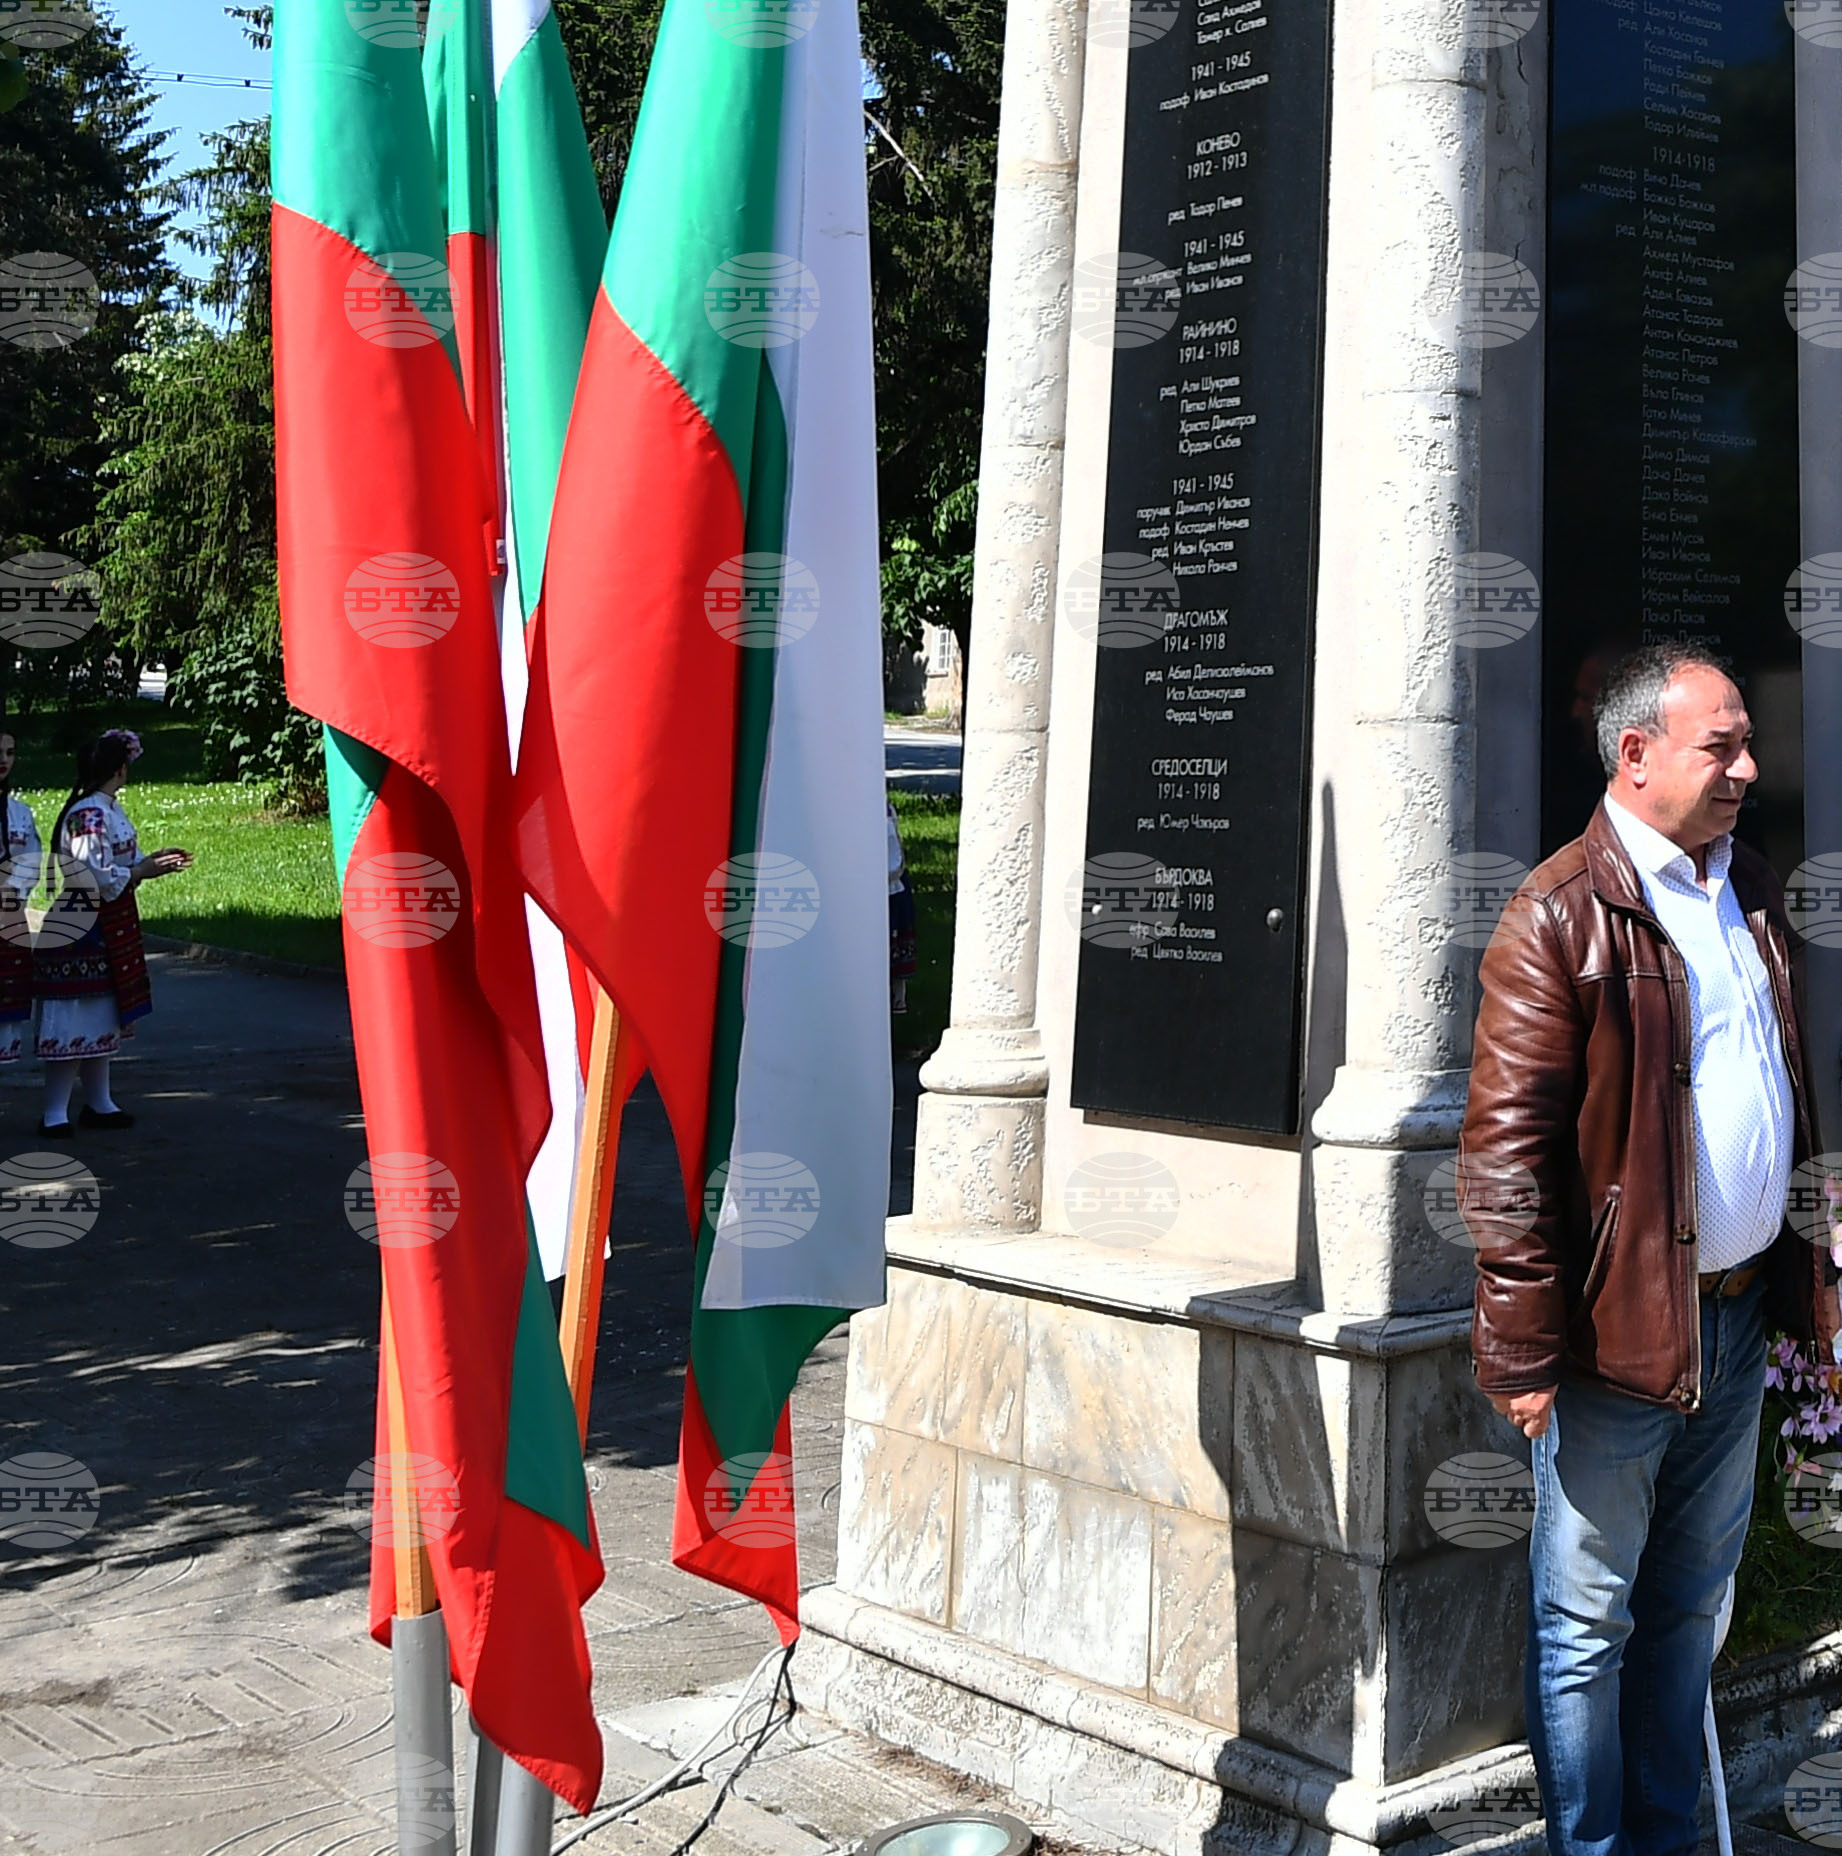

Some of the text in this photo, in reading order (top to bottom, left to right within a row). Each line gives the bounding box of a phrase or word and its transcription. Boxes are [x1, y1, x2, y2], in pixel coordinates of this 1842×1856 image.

[1222, 0, 1261, 18] Ахмедов
[1192, 62, 1214, 81] 1941
[1226, 51, 1251, 72] 1945
[1194, 87, 1216, 101] Иван
[1219, 74, 1269, 95] Костадинов
[1196, 132, 1240, 156] КОНЕВО
[1187, 160, 1211, 179] 1912
[1222, 152, 1247, 172] 1913
[1190, 202, 1215, 216] Тодор
[1184, 238, 1207, 257] 1941
[1219, 230, 1244, 249] 1945
[1186, 282, 1209, 294] Иван
[1211, 275, 1243, 290] Иванов
[1183, 318, 1237, 341] РАЙНИНО
[1180, 346, 1204, 363] 1914
[1215, 340, 1240, 358] 1918
[1682, 348, 1719, 368] Петров
[1181, 380, 1199, 393] Али
[1180, 399, 1206, 414] Петко
[1179, 414, 1256, 437] Христо Димитров
[1173, 478, 1196, 495] 1941
[1208, 473, 1234, 491] 1945
[1175, 500, 1215, 515] Димитър
[1217, 496, 1251, 510] Иванов
[1175, 520, 1216, 535] Костадин
[1173, 541, 1196, 556] Иван
[1198, 538, 1234, 557] Кръстев
[1173, 562, 1205, 576] Никола
[1164, 609, 1229, 631] ДРАГОМЪЖ
[1164, 636, 1189, 652] 1914
[1200, 633, 1225, 650] 1918
[1167, 686, 1185, 701] Иса
[1166, 706, 1233, 726] Ферад Чаушев
[1152, 758, 1228, 777] СРЕДОСЕЛЦИ
[1158, 783, 1183, 799] 1914
[1194, 783, 1220, 800] 1918
[1160, 813, 1189, 832] Юмер
[1155, 868, 1213, 887] БЪРДОКВА
[1152, 892, 1177, 908] 1914
[1188, 893, 1214, 911] 1918
[1179, 922, 1216, 939] Василев
[1186, 946, 1222, 962] Василев
